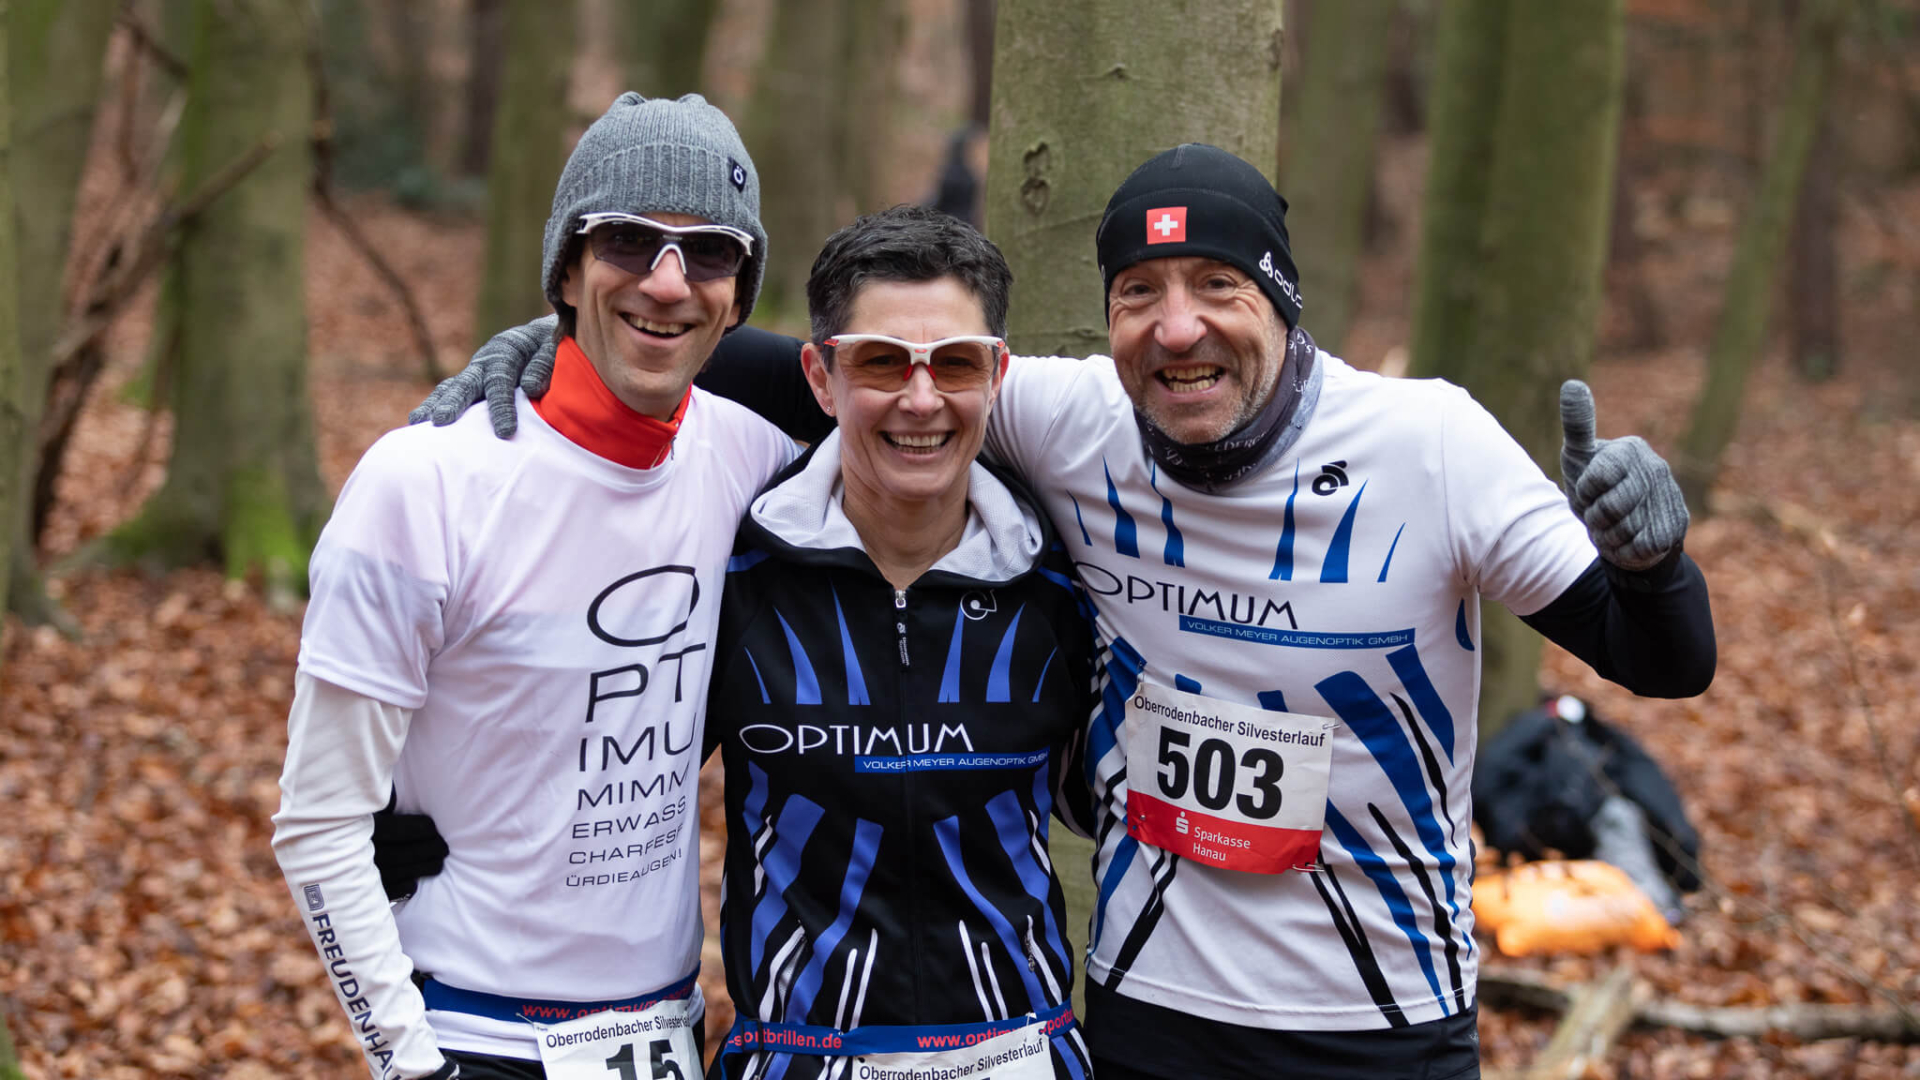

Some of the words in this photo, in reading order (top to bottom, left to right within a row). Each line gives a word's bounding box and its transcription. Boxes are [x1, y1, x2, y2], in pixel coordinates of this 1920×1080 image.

[587, 565, 700, 647] O
[1075, 561, 1299, 630] OPTIMUM
[1187, 621, 1232, 635] VOLKER
[1235, 629, 1277, 641] MEYER
[1280, 634, 1364, 646] AUGENOPTIK
[1368, 633, 1408, 645] GMBH
[585, 642, 706, 723] PT
[579, 712, 697, 772] IMU
[739, 723, 974, 755] OPTIMUM
[1134, 696, 1235, 733] Oberrodenbacher
[1237, 721, 1326, 747] Silvesterlauf
[863, 759, 912, 770] VOLKER
[913, 757, 954, 768] MEYER
[958, 756, 1027, 766] AUGENOPTIK
[1157, 725, 1284, 820] 503
[572, 795, 686, 839] ERWASS
[1194, 827, 1251, 849] Sparkasse
[1193, 843, 1226, 862] Hanau
[546, 1019, 653, 1048] Oberrodenbacher
[859, 1063, 975, 1080] Oberrodenbacher
[977, 1038, 1044, 1072] Silvesterlauf
